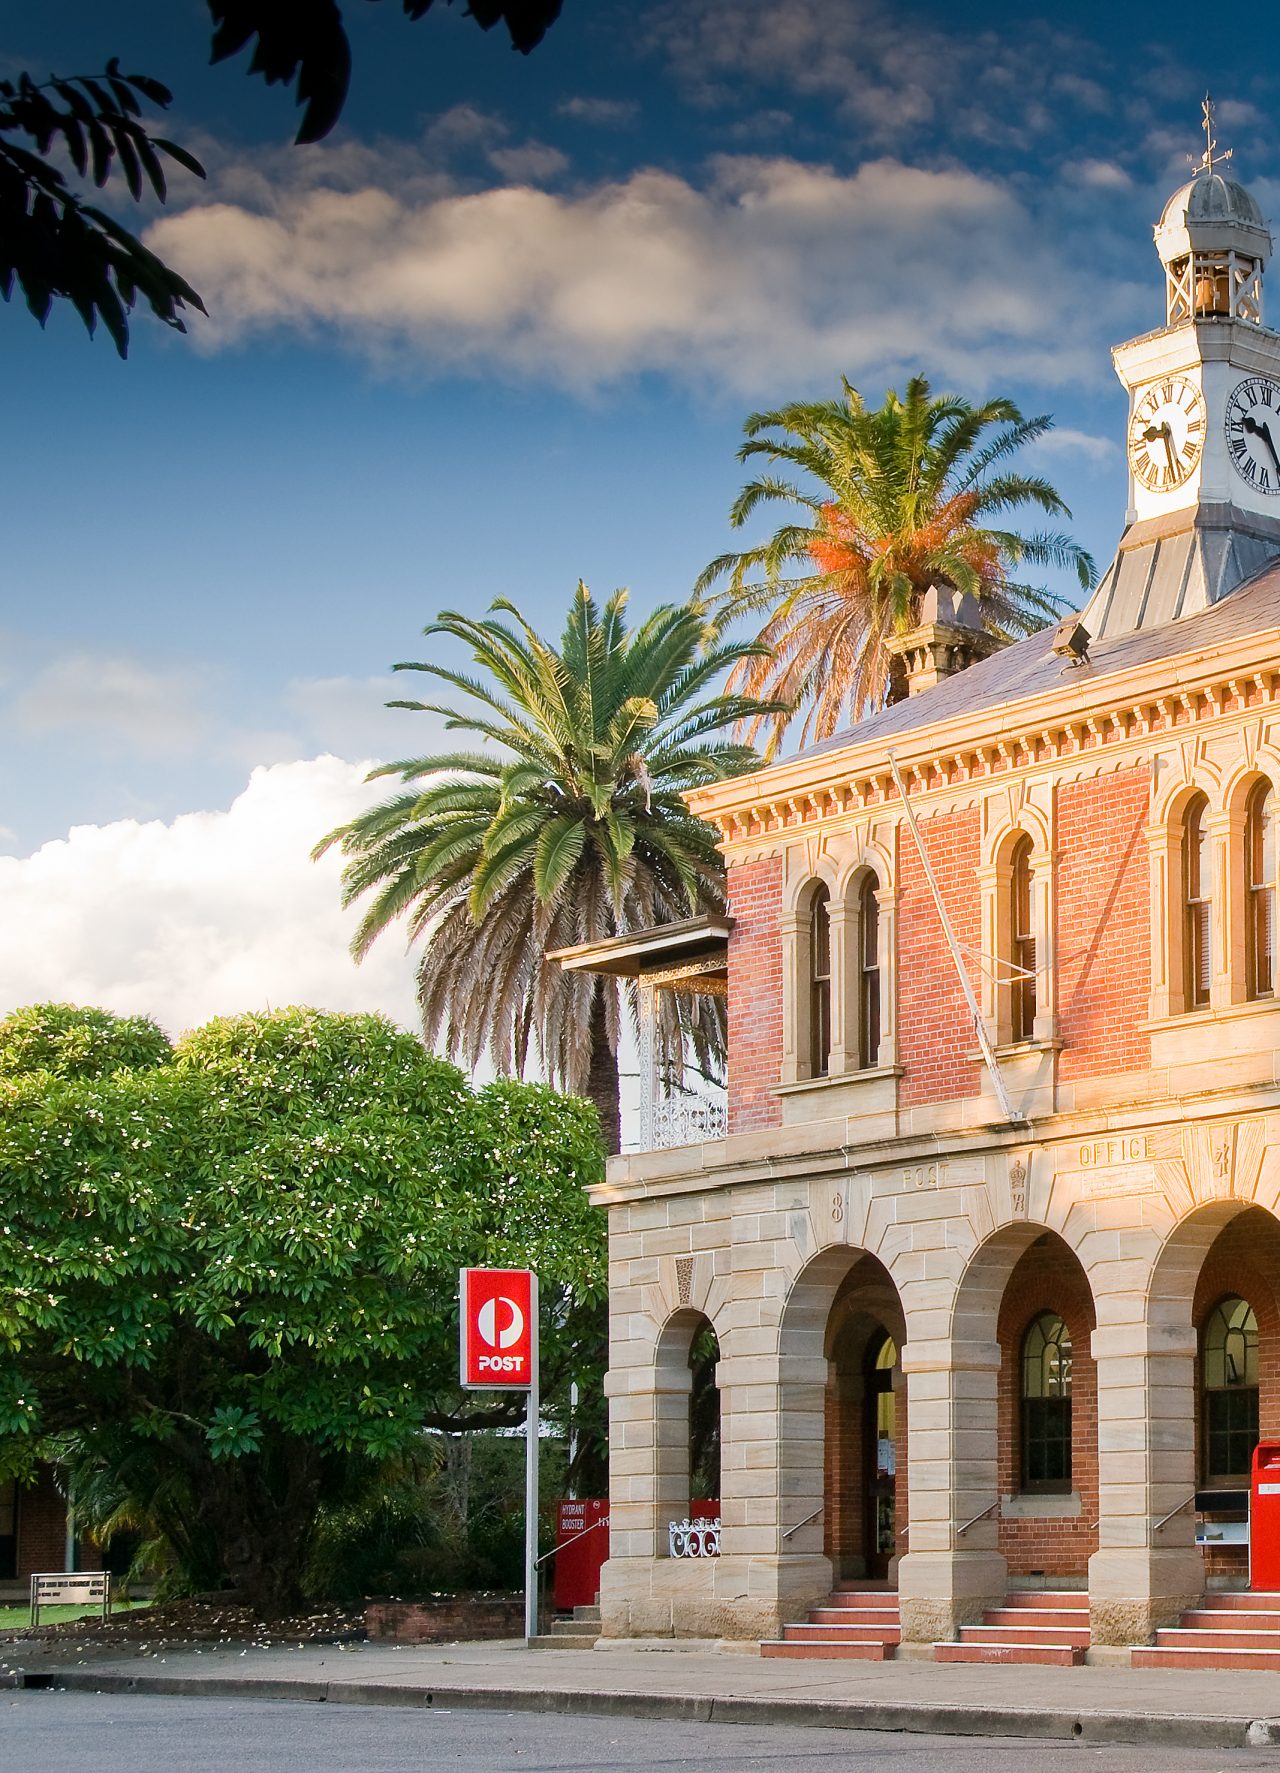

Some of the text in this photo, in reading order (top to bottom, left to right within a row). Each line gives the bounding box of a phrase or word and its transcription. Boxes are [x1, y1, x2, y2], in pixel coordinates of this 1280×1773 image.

[902, 1136, 1157, 1190] POST OFFICE
[479, 1356, 524, 1371] POST
[562, 1504, 585, 1515] HYDRANT
[561, 1519, 584, 1530] BOOSTER
